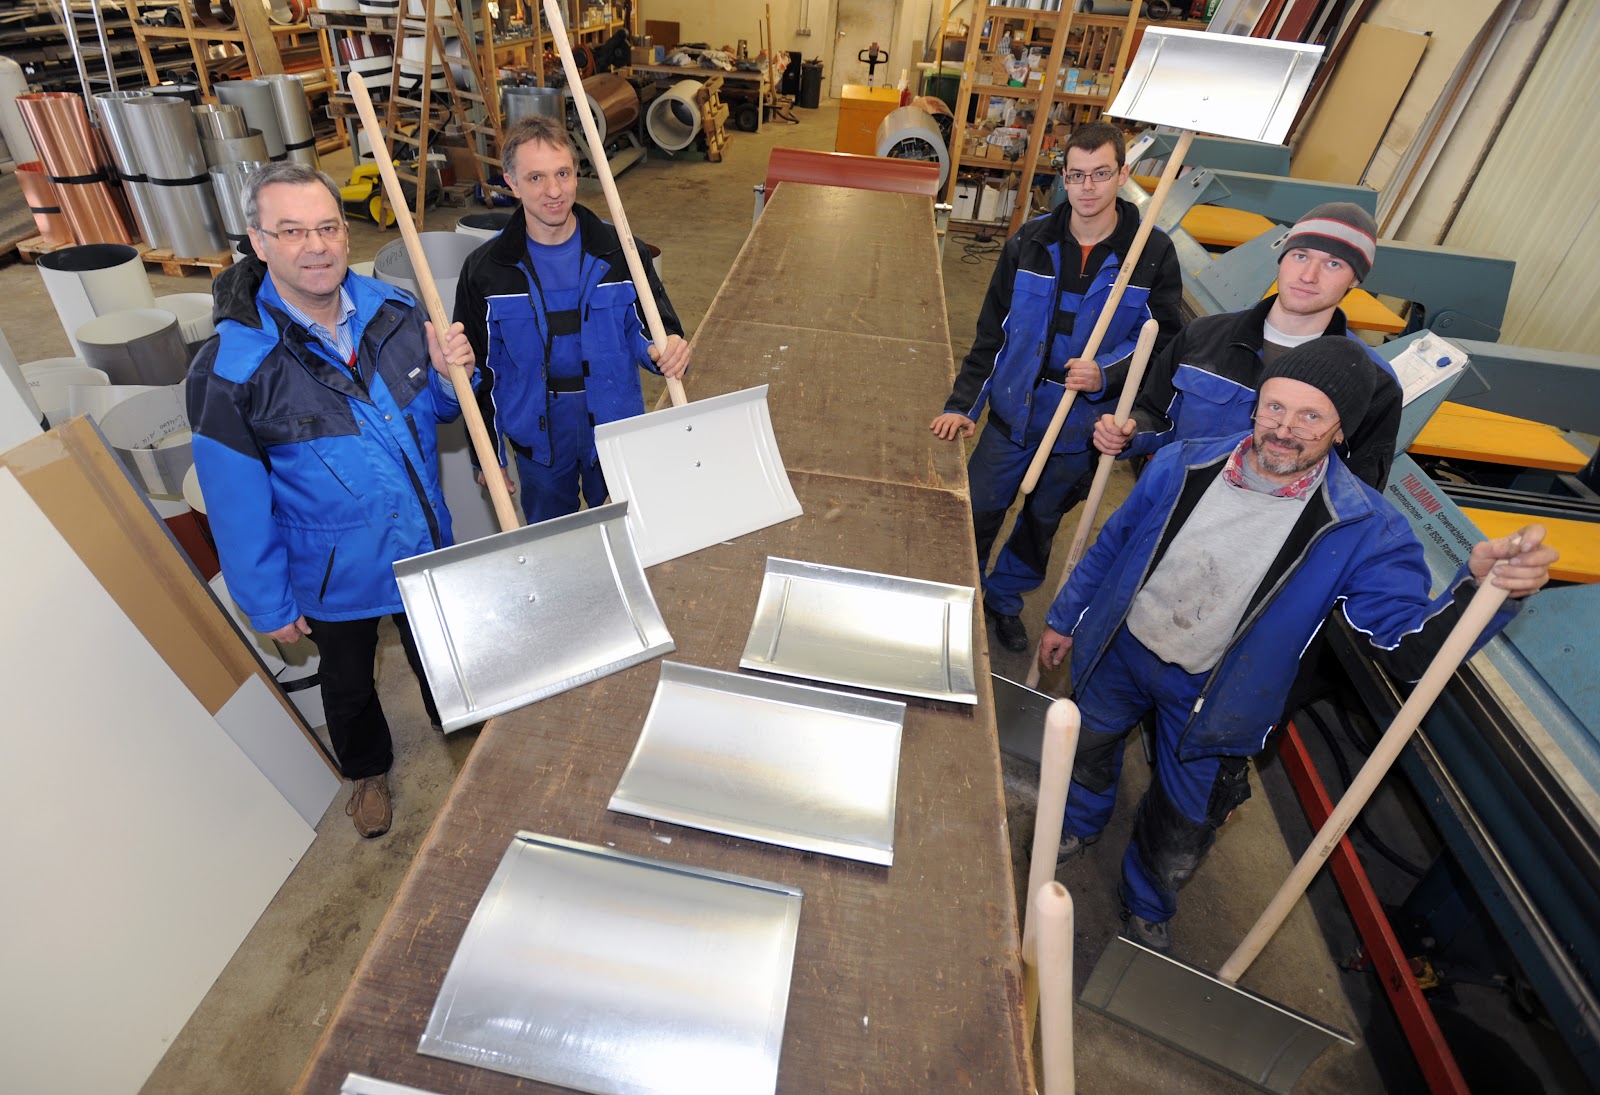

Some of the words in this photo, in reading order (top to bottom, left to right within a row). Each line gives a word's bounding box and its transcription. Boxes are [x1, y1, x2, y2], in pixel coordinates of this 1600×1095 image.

[1388, 483, 1424, 521] Abkantmaschinen
[1440, 543, 1464, 568] Frauenfe
[1399, 472, 1443, 515] THALMANN
[1435, 511, 1475, 555] Schwenkbiegete
